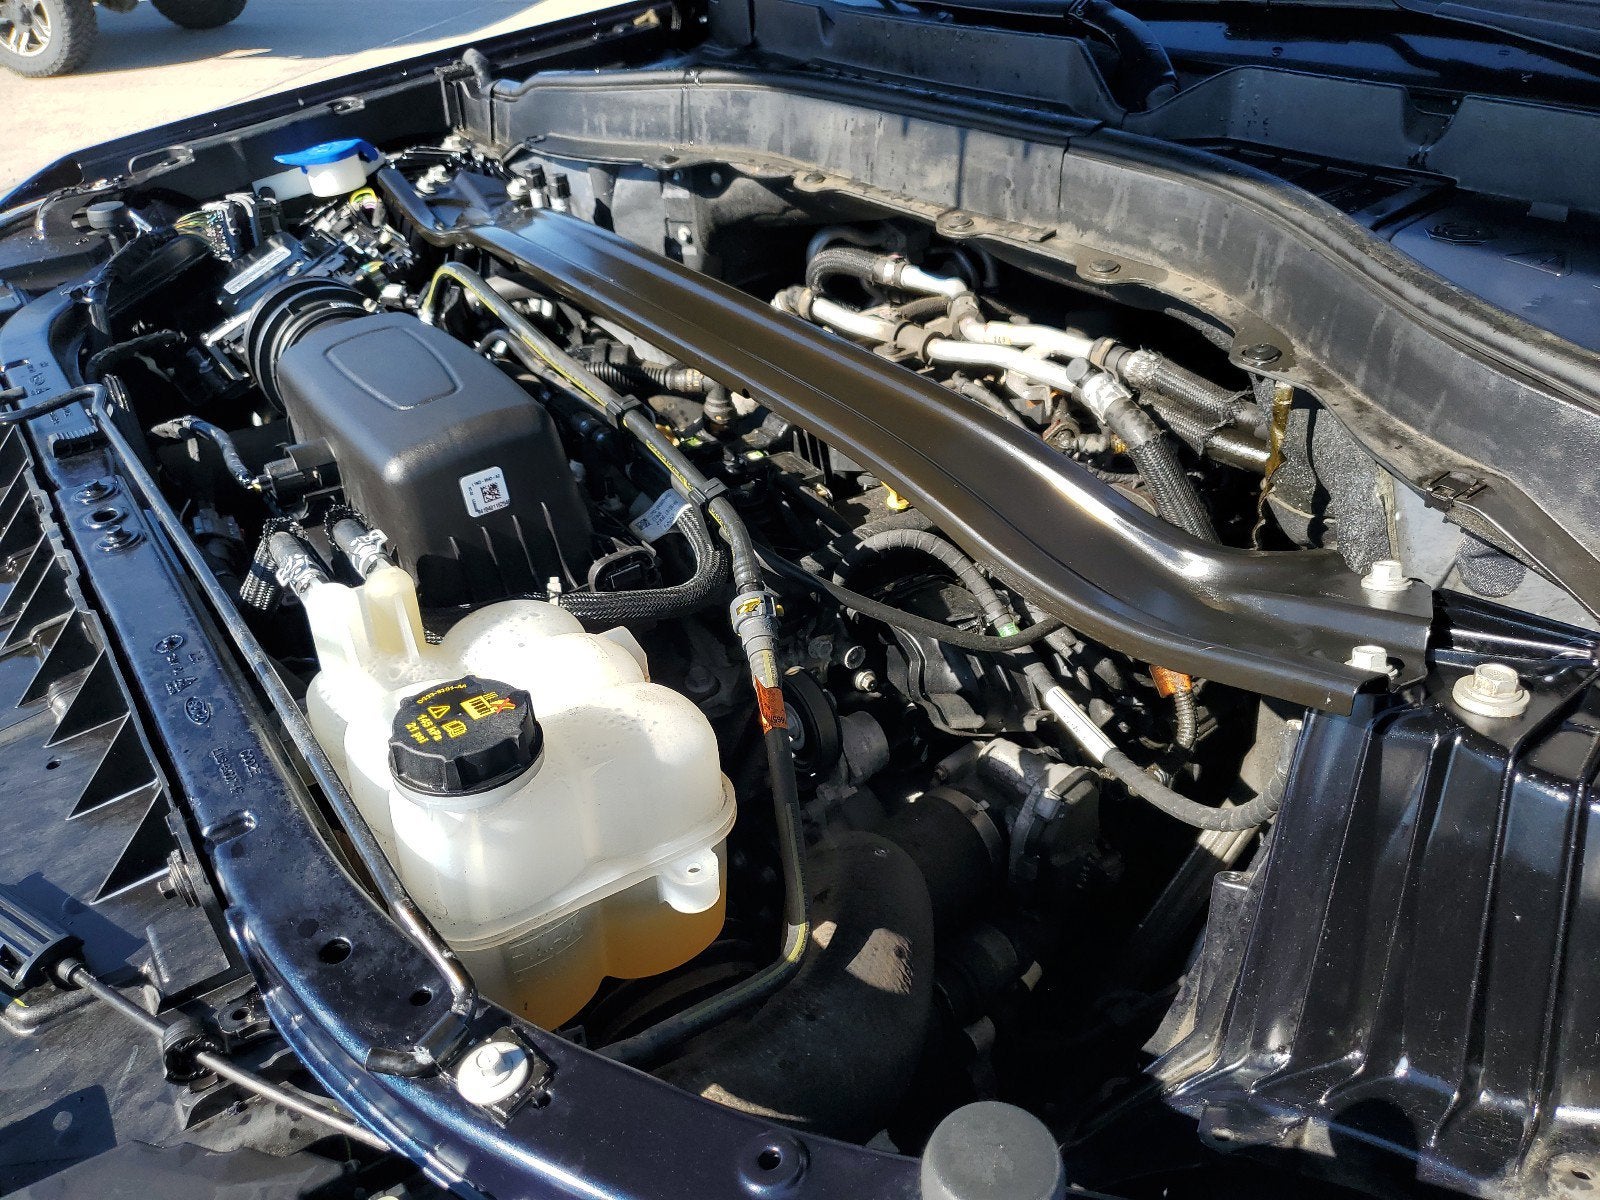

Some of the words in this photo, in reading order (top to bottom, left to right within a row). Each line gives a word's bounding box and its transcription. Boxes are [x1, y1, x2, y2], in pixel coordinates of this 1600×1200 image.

[405, 722, 419, 731] 21
[417, 714, 433, 728] 145
[426, 726, 442, 741] kPa
[410, 732, 429, 743] psi
